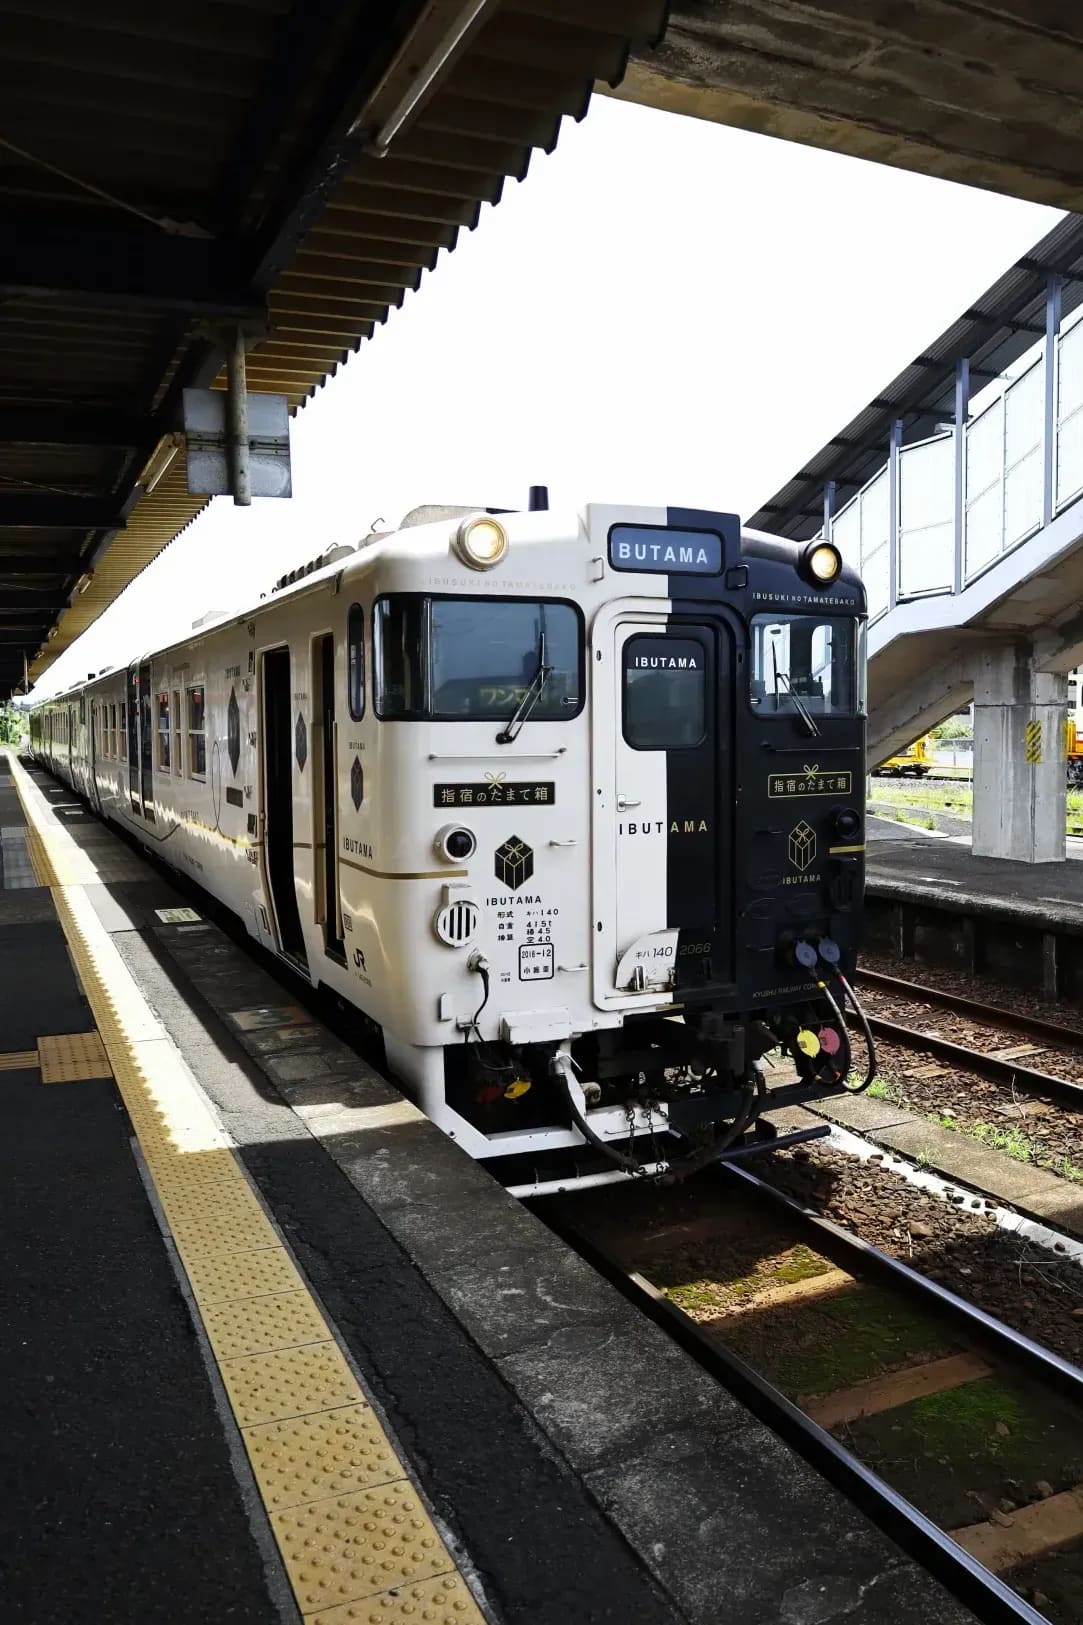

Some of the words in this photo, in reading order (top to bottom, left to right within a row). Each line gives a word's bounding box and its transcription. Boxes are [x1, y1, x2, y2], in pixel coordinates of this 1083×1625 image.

[752, 592, 789, 601] IBUSUKI
[803, 595, 855, 606] TAMATEBAKO
[635, 656, 697, 668] IBUTAMA
[774, 777, 847, 793] 指宿のたまて箱
[441, 786, 549, 803] 指宿のたまて箱
[618, 820, 708, 835] IBUTAMA
[343, 836, 373, 861] IBUTAMA
[782, 873, 821, 885] IBUTAMA
[486, 895, 542, 906] IBUTAMA
[353, 947, 367, 972] JR
